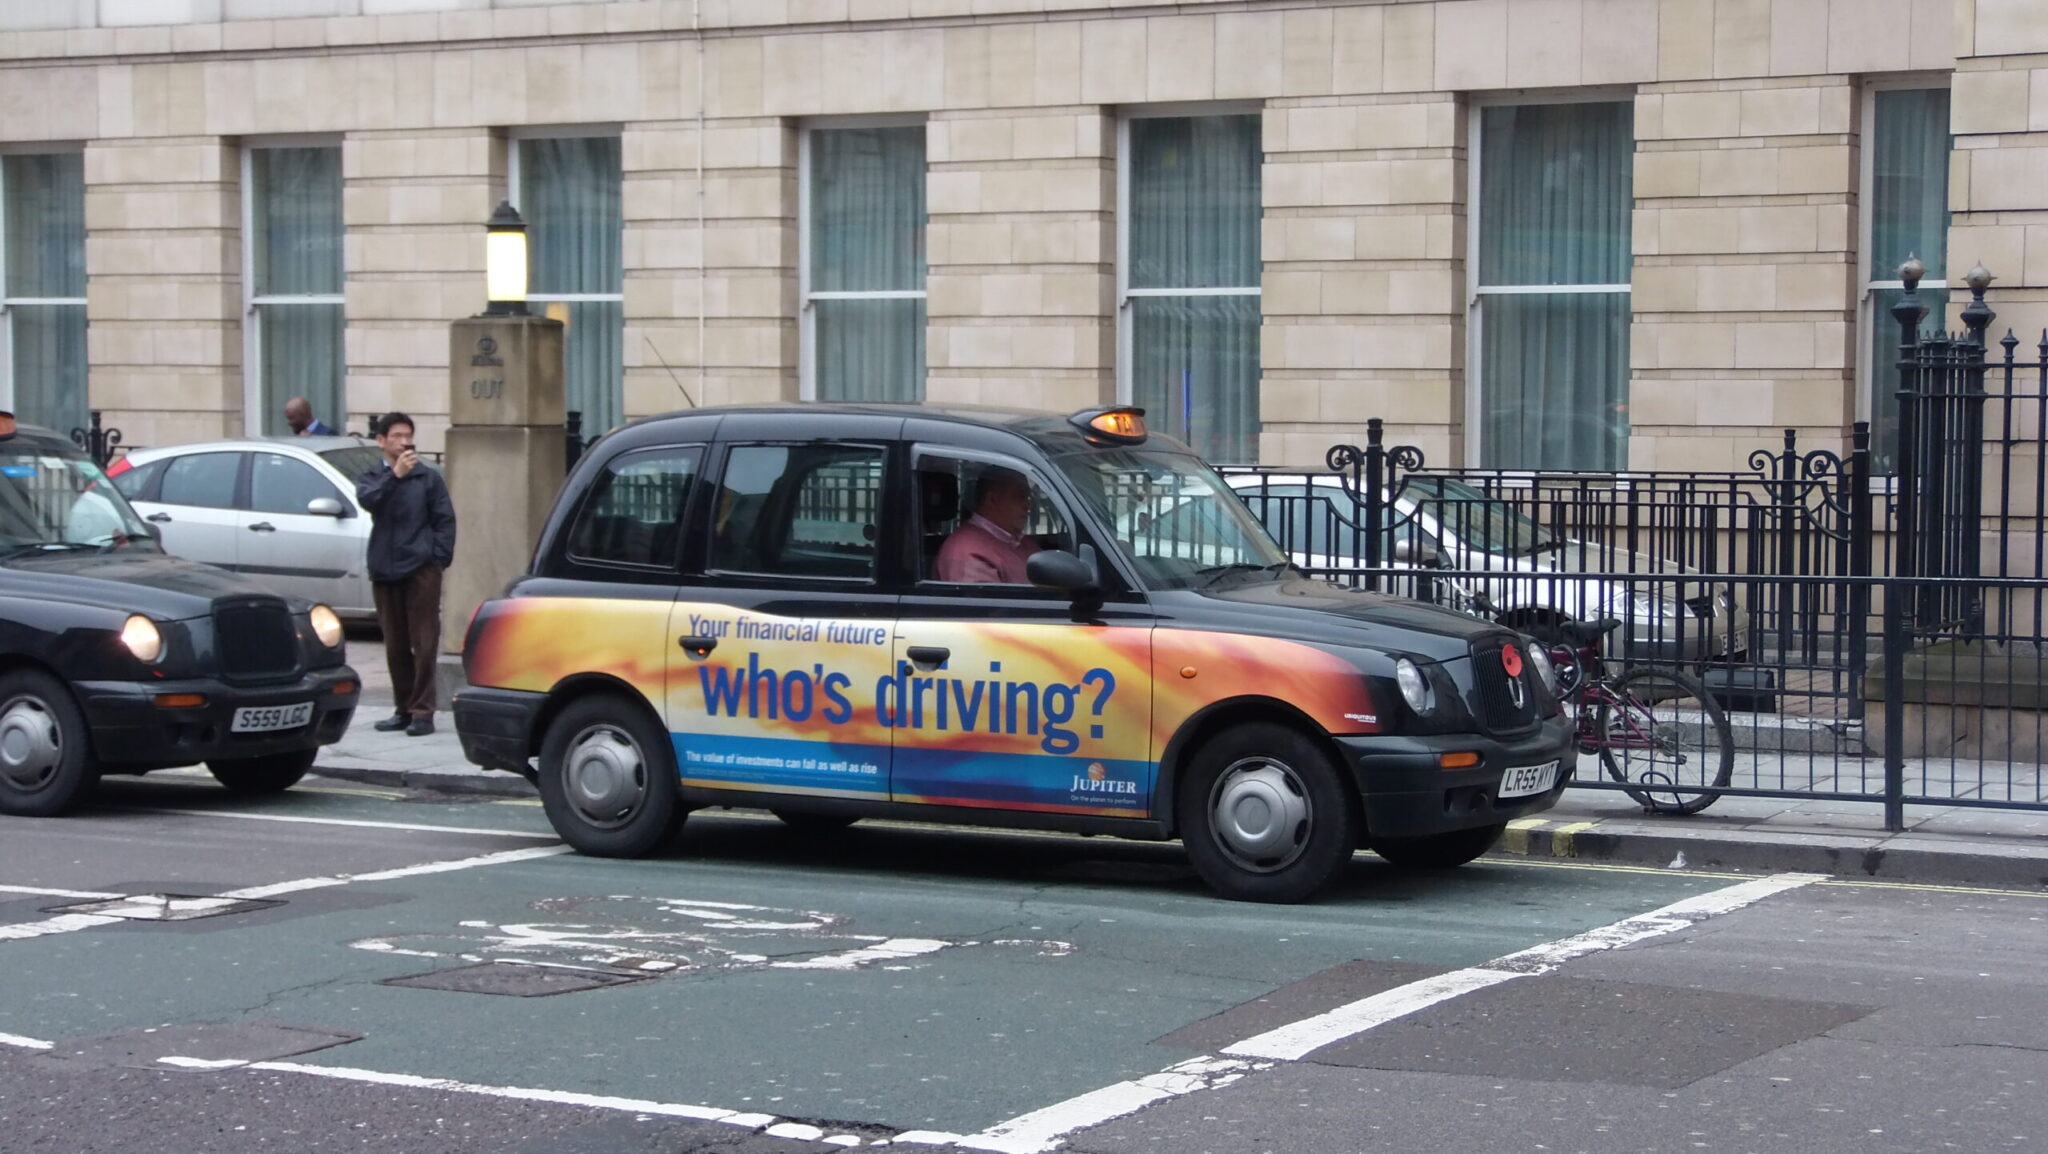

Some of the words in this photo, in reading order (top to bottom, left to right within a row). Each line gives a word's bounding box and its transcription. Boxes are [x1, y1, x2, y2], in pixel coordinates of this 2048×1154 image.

[471, 378, 504, 399] OUT
[689, 614, 731, 638] Your
[736, 616, 820, 642] financial
[826, 622, 887, 646] future
[698, 652, 853, 725] who's
[876, 660, 1116, 755] driving?
[240, 709, 281, 728] S559
[686, 750, 701, 761] The
[703, 752, 725, 764] value
[726, 754, 735, 764] of
[735, 754, 784, 768] investments
[785, 759, 801, 769] can
[803, 758, 817, 770] fall
[817, 761, 828, 771] as
[829, 761, 848, 772] well
[848, 763, 860, 773] as
[860, 762, 878, 774] rise
[1070, 774, 1137, 794] JUPITER
[1504, 767, 1539, 792] LR55
